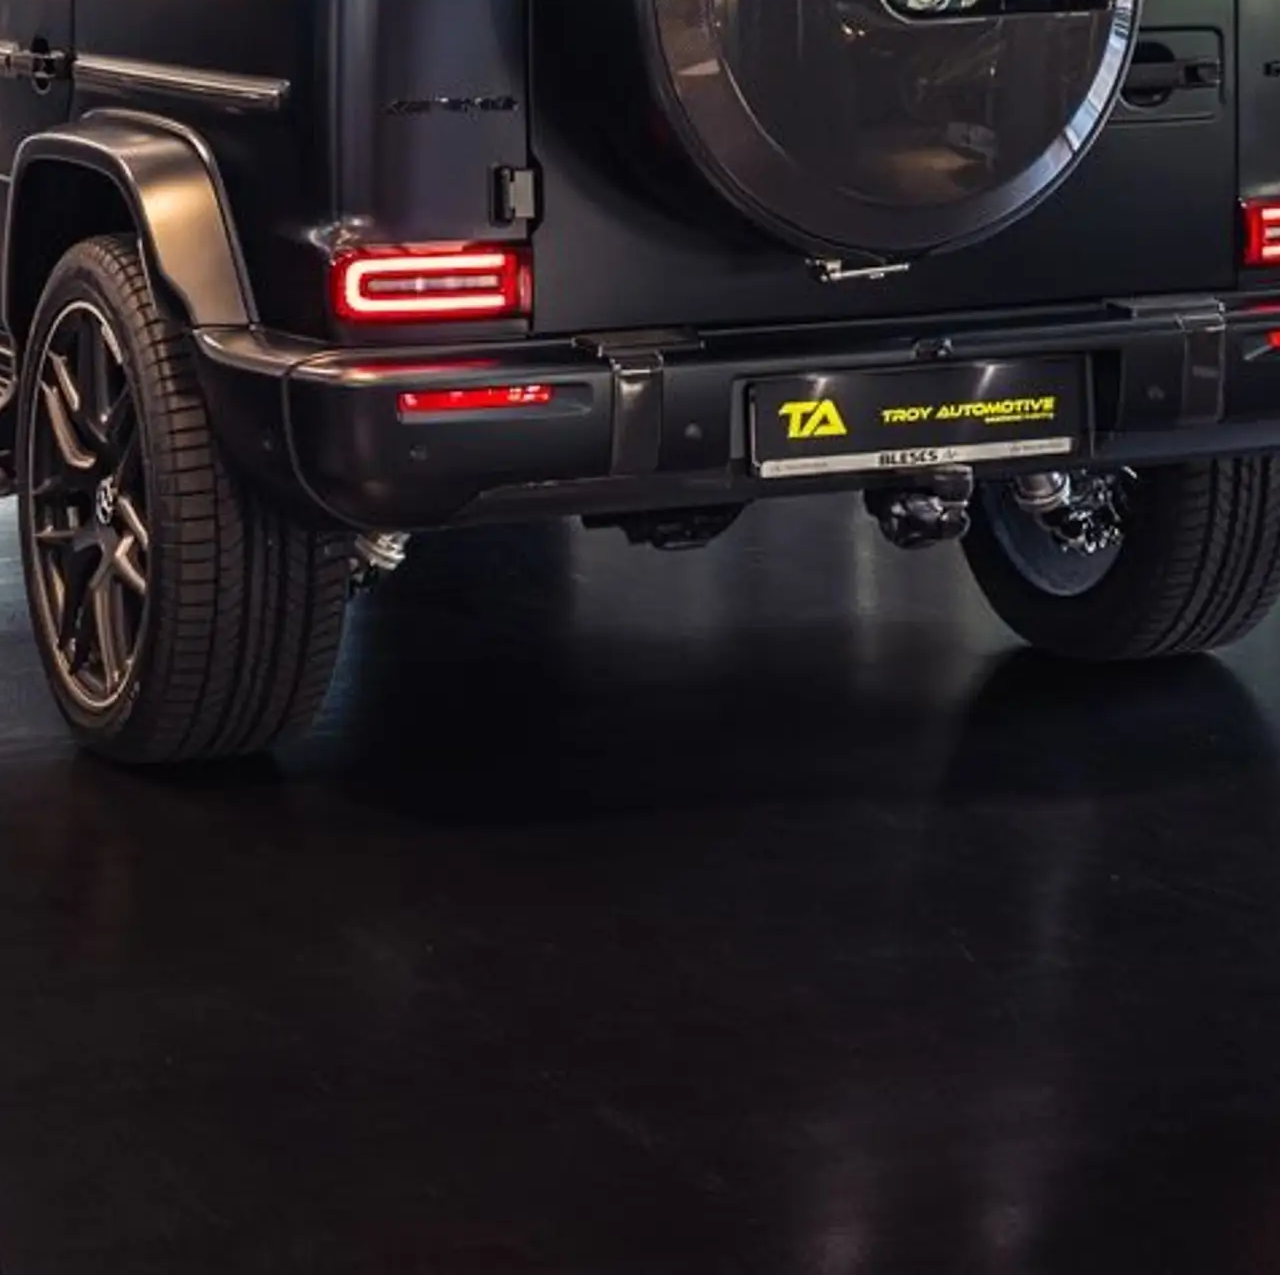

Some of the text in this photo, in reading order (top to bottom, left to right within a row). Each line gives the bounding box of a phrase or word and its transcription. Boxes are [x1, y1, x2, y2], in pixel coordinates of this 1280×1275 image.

[778, 399, 848, 439] TA
[881, 405, 933, 424] TROY
[936, 396, 1056, 421] AUTOMOTIVE
